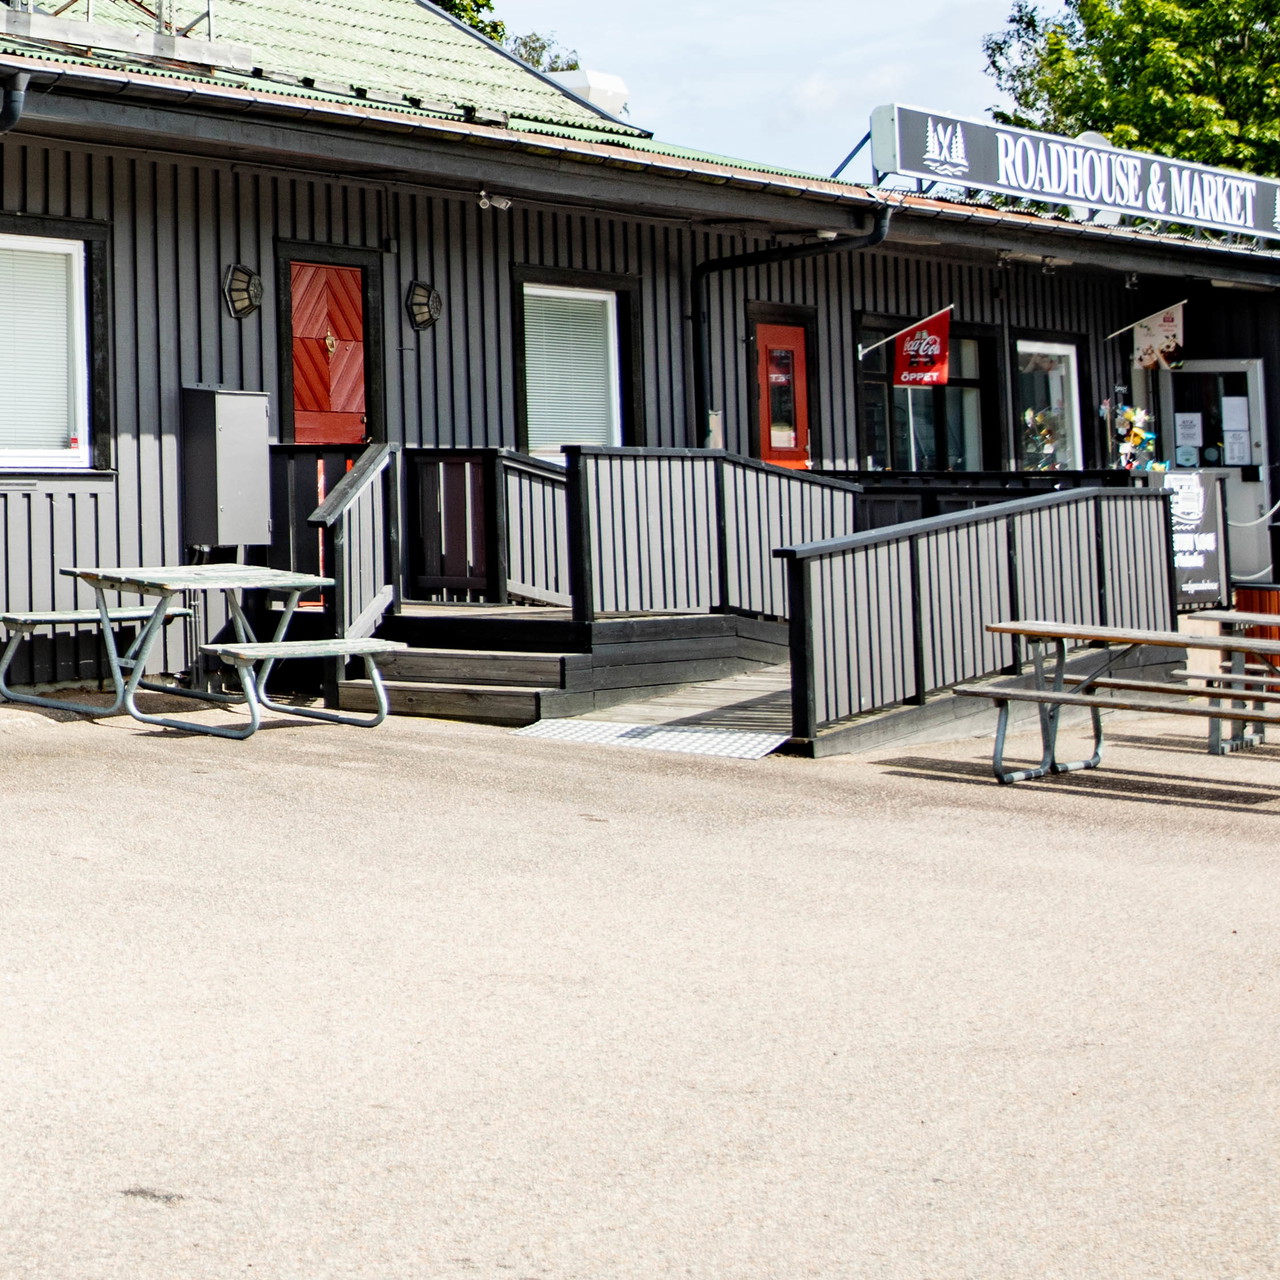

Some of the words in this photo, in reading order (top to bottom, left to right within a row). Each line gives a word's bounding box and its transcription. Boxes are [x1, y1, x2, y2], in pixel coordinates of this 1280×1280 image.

[995, 131, 1143, 208] ROADHOUSE
[1146, 161, 1167, 213] &
[1168, 166, 1257, 228] MARKET
[901, 371, 940, 382] ÖPPET
